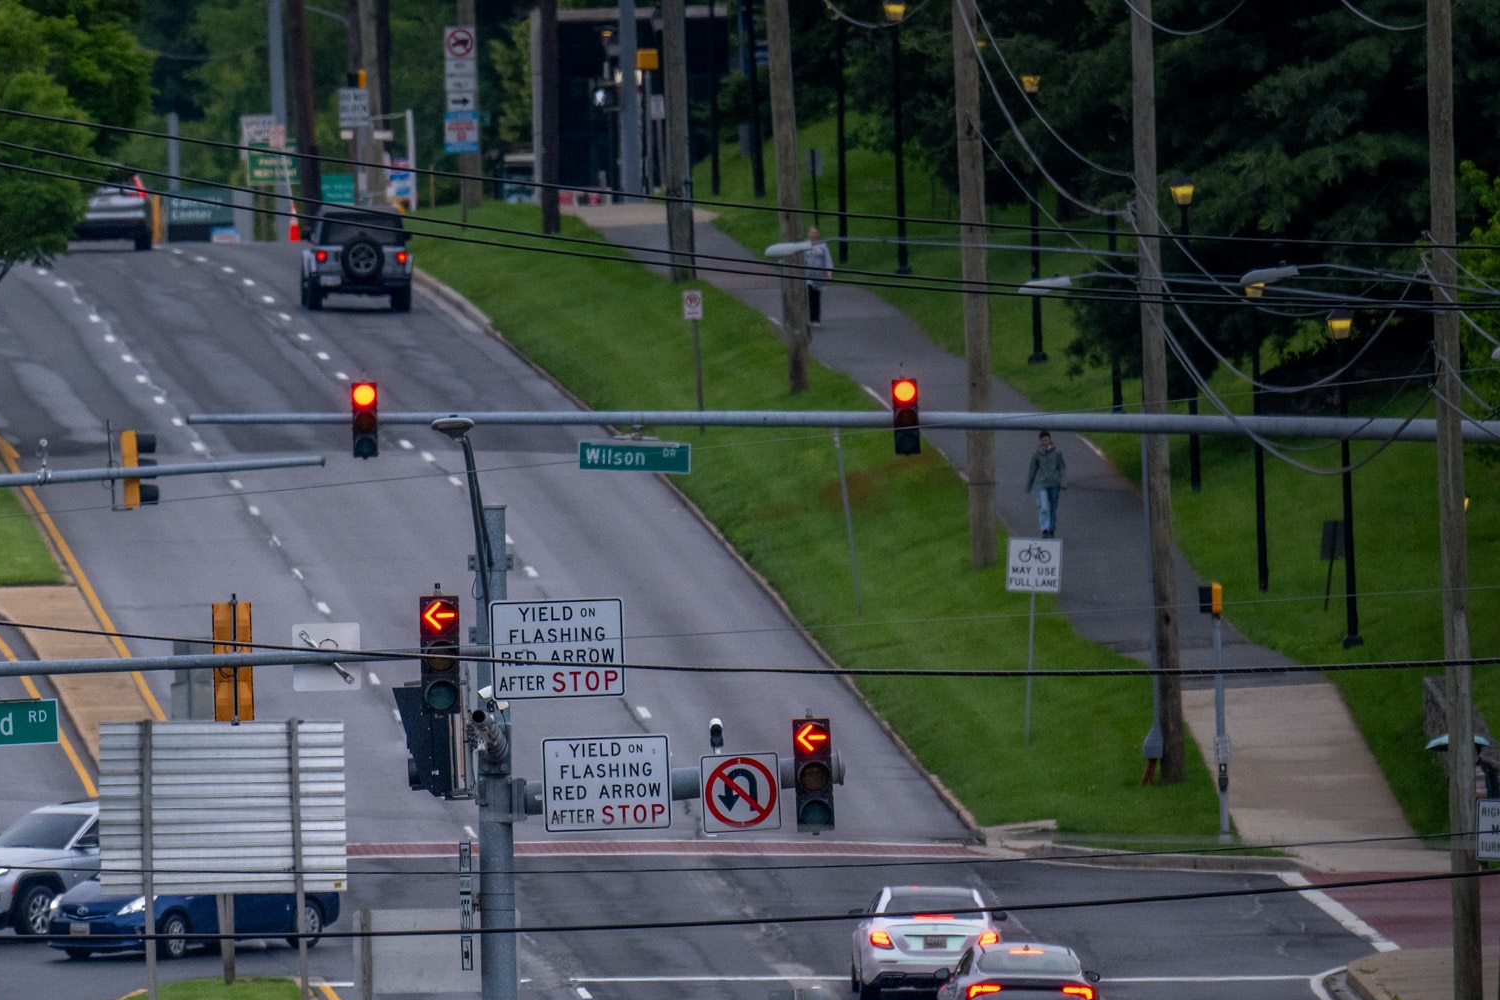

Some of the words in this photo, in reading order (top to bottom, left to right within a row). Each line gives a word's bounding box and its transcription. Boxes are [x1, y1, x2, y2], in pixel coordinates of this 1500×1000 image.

[586, 448, 645, 466] Wilson
[662, 448, 676, 458] DR
[1011, 566, 1032, 575] MAY
[1037, 567, 1057, 577] USE
[1009, 577, 1032, 587] FULL
[1035, 578, 1058, 588] LANE
[518, 606, 573, 622] YIELD
[580, 607, 596, 618] ON
[509, 626, 606, 644] FLASHING
[501, 651, 537, 667] RED
[551, 648, 615, 666] ARROW
[500, 675, 545, 692] AFTER
[552, 669, 619, 693] STOP
[28, 709, 48, 723] RD
[569, 742, 621, 758] YIELD
[628, 744, 643, 753] ON
[560, 762, 652, 780] FLASHING
[552, 785, 587, 801] RED
[599, 782, 661, 799] ARROW
[551, 808, 595, 825] AFTER
[601, 803, 666, 826] STOP
